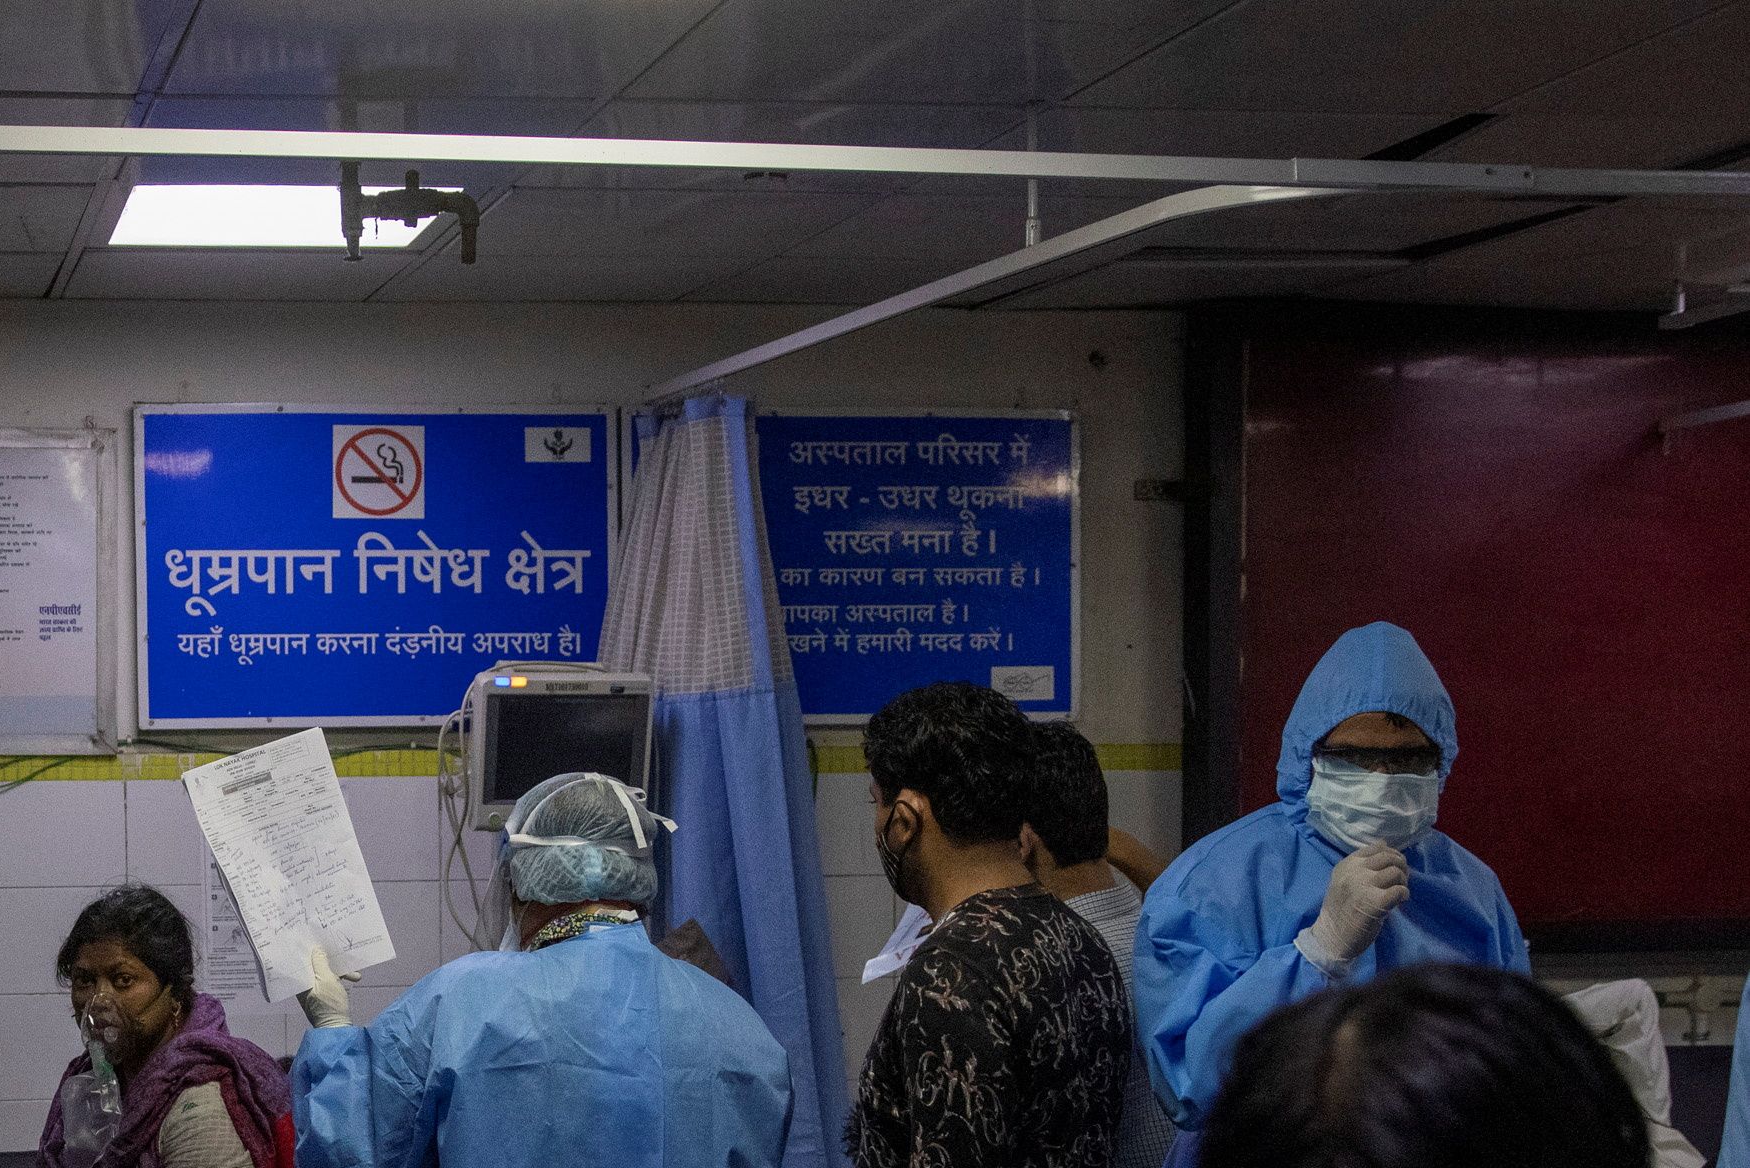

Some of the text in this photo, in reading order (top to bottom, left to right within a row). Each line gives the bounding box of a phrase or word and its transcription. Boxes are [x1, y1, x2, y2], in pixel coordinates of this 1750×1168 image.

[790, 433, 1031, 465] अस्पताल परिसर में
[794, 486, 851, 514] इधर
[878, 486, 939, 509] उधर
[947, 485, 1025, 522] थूकना
[824, 530, 896, 554] सख्त
[901, 530, 954, 554] मना
[961, 521, 983, 556] है
[165, 530, 592, 617] धूम्रपान निषेध क्षेत्र
[780, 568, 813, 586] का
[819, 568, 883, 586] कारण
[933, 568, 1003, 586] सकता
[1010, 560, 1027, 588] है
[845, 605, 935, 625] अस्पताल
[941, 598, 957, 625] है
[178, 626, 222, 658] यहाँ
[229, 632, 310, 665] धूम्रपान
[316, 632, 376, 655] करना
[472, 632, 551, 655] अपराध
[788, 626, 827, 653] खने
[834, 626, 850, 652] में
[856, 627, 912, 654] हमारी
[919, 633, 962, 652] मदद
[969, 626, 1002, 652] करें
[224, 758, 240, 766] NAYAK
[242, 750, 266, 761] HOSPITAL
